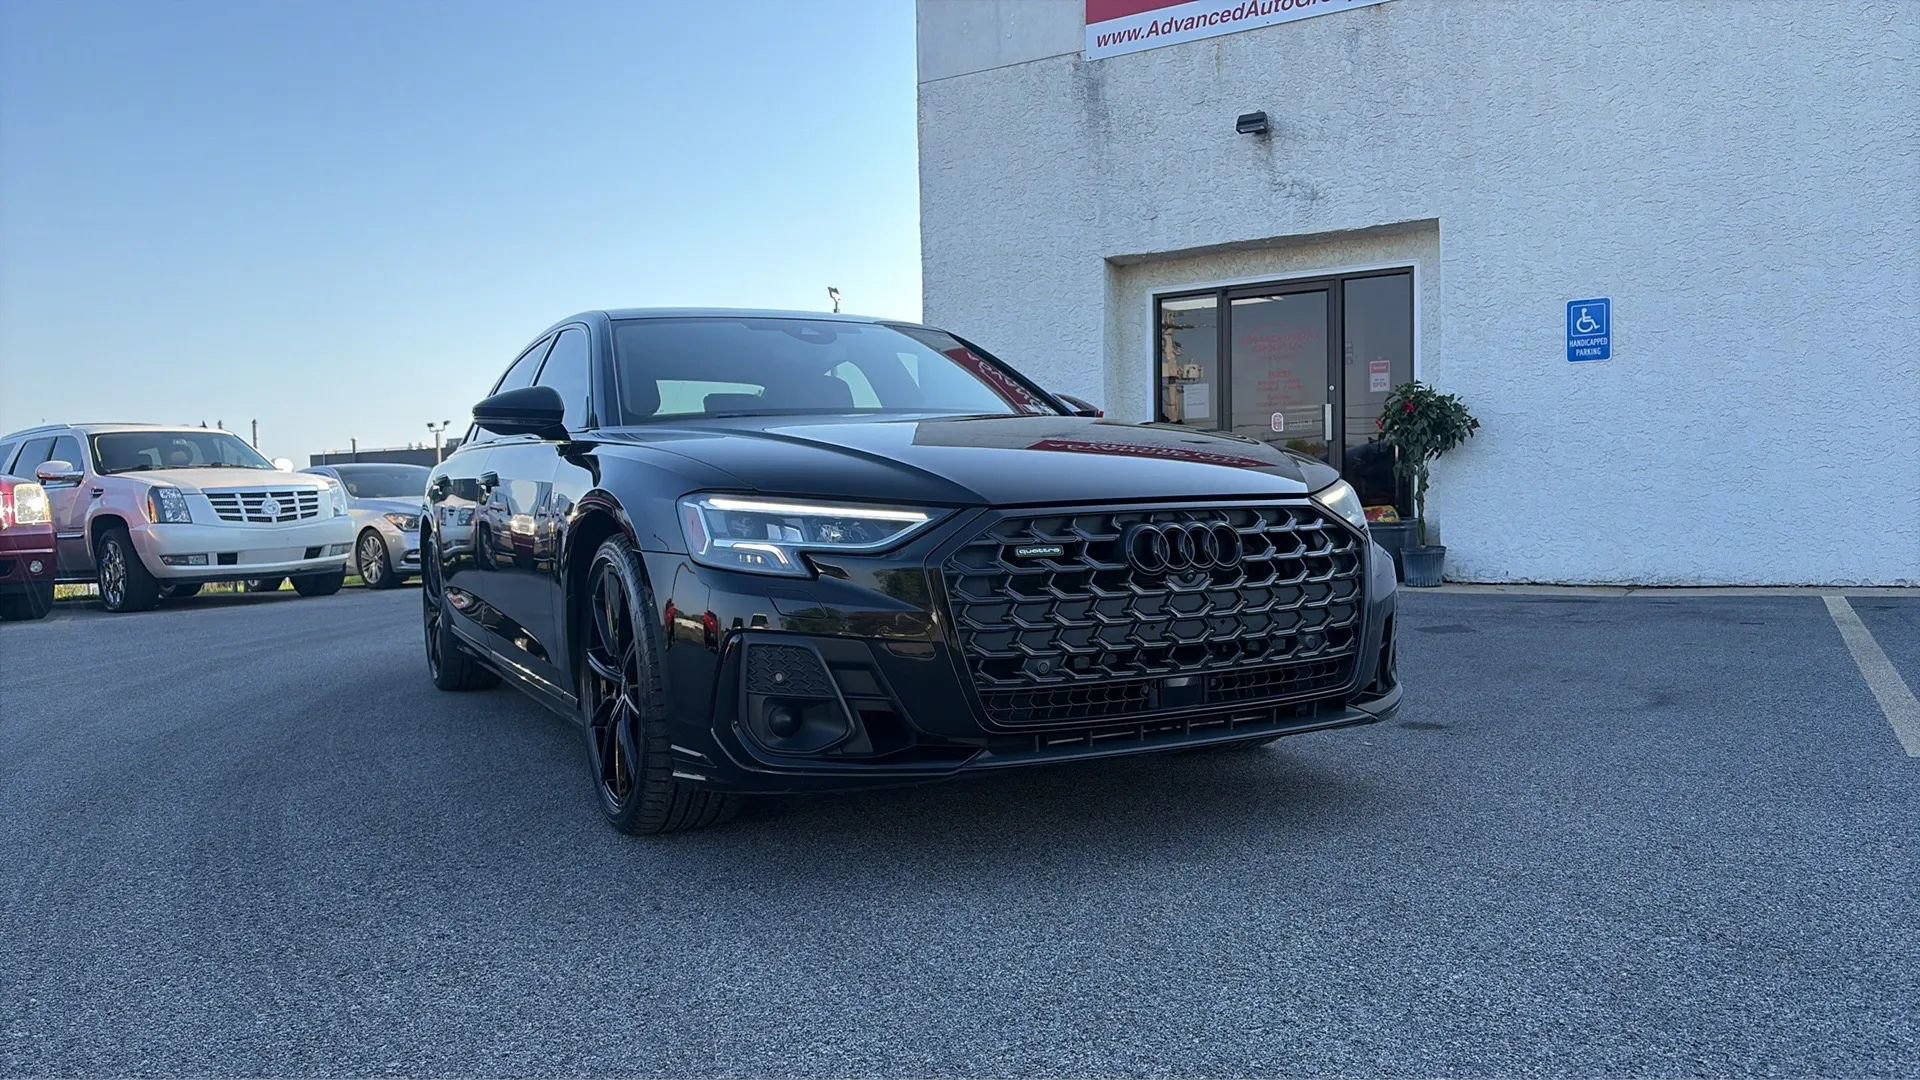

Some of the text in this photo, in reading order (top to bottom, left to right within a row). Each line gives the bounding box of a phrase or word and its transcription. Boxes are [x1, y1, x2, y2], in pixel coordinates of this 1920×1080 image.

[1569, 337, 1607, 347] HANDICAPPED
[1575, 347, 1601, 356] PARKING
[1018, 547, 1060, 555] quattro
